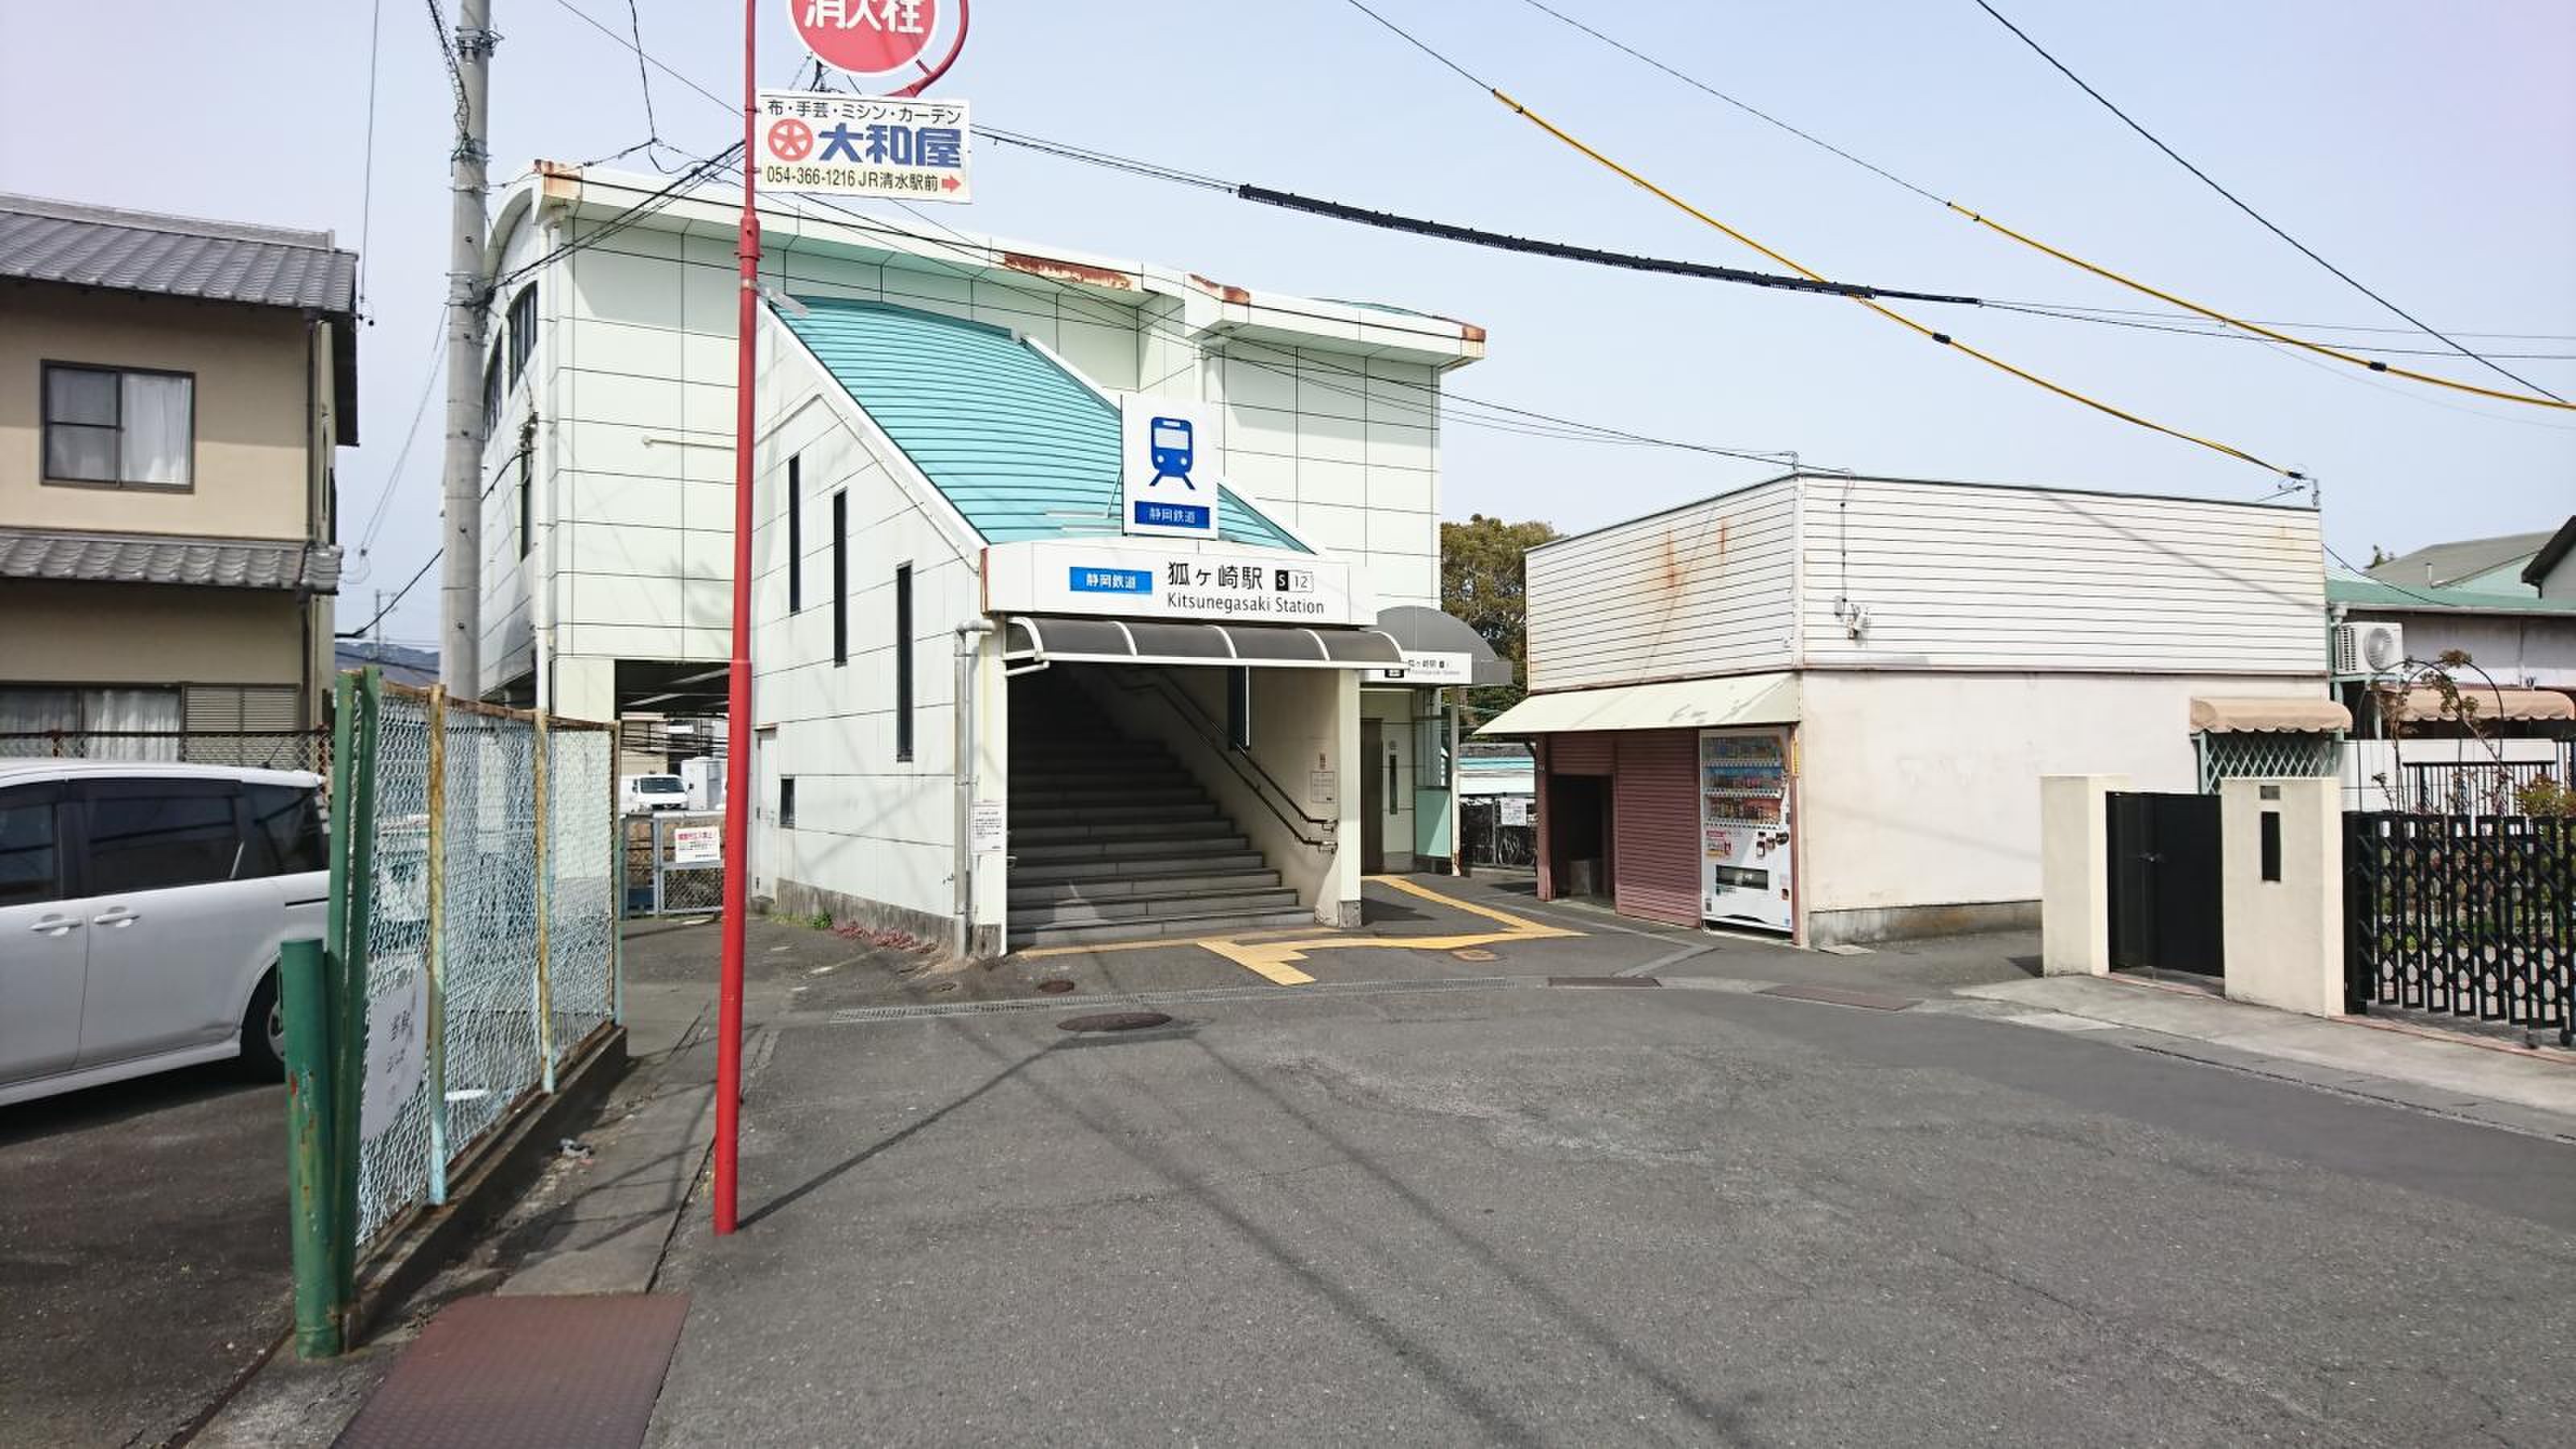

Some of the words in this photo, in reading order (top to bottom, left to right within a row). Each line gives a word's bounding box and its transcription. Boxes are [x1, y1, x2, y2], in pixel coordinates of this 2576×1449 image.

[819, 122, 962, 168] 大和屋
[766, 166, 857, 187] 054-366-1216
[858, 171, 939, 192] JR清水駅前
[1278, 576, 1286, 587] S
[1294, 575, 1309, 588] 12
[1167, 592, 1271, 614] Kitsunegasaki
[1275, 596, 1325, 614] Station
